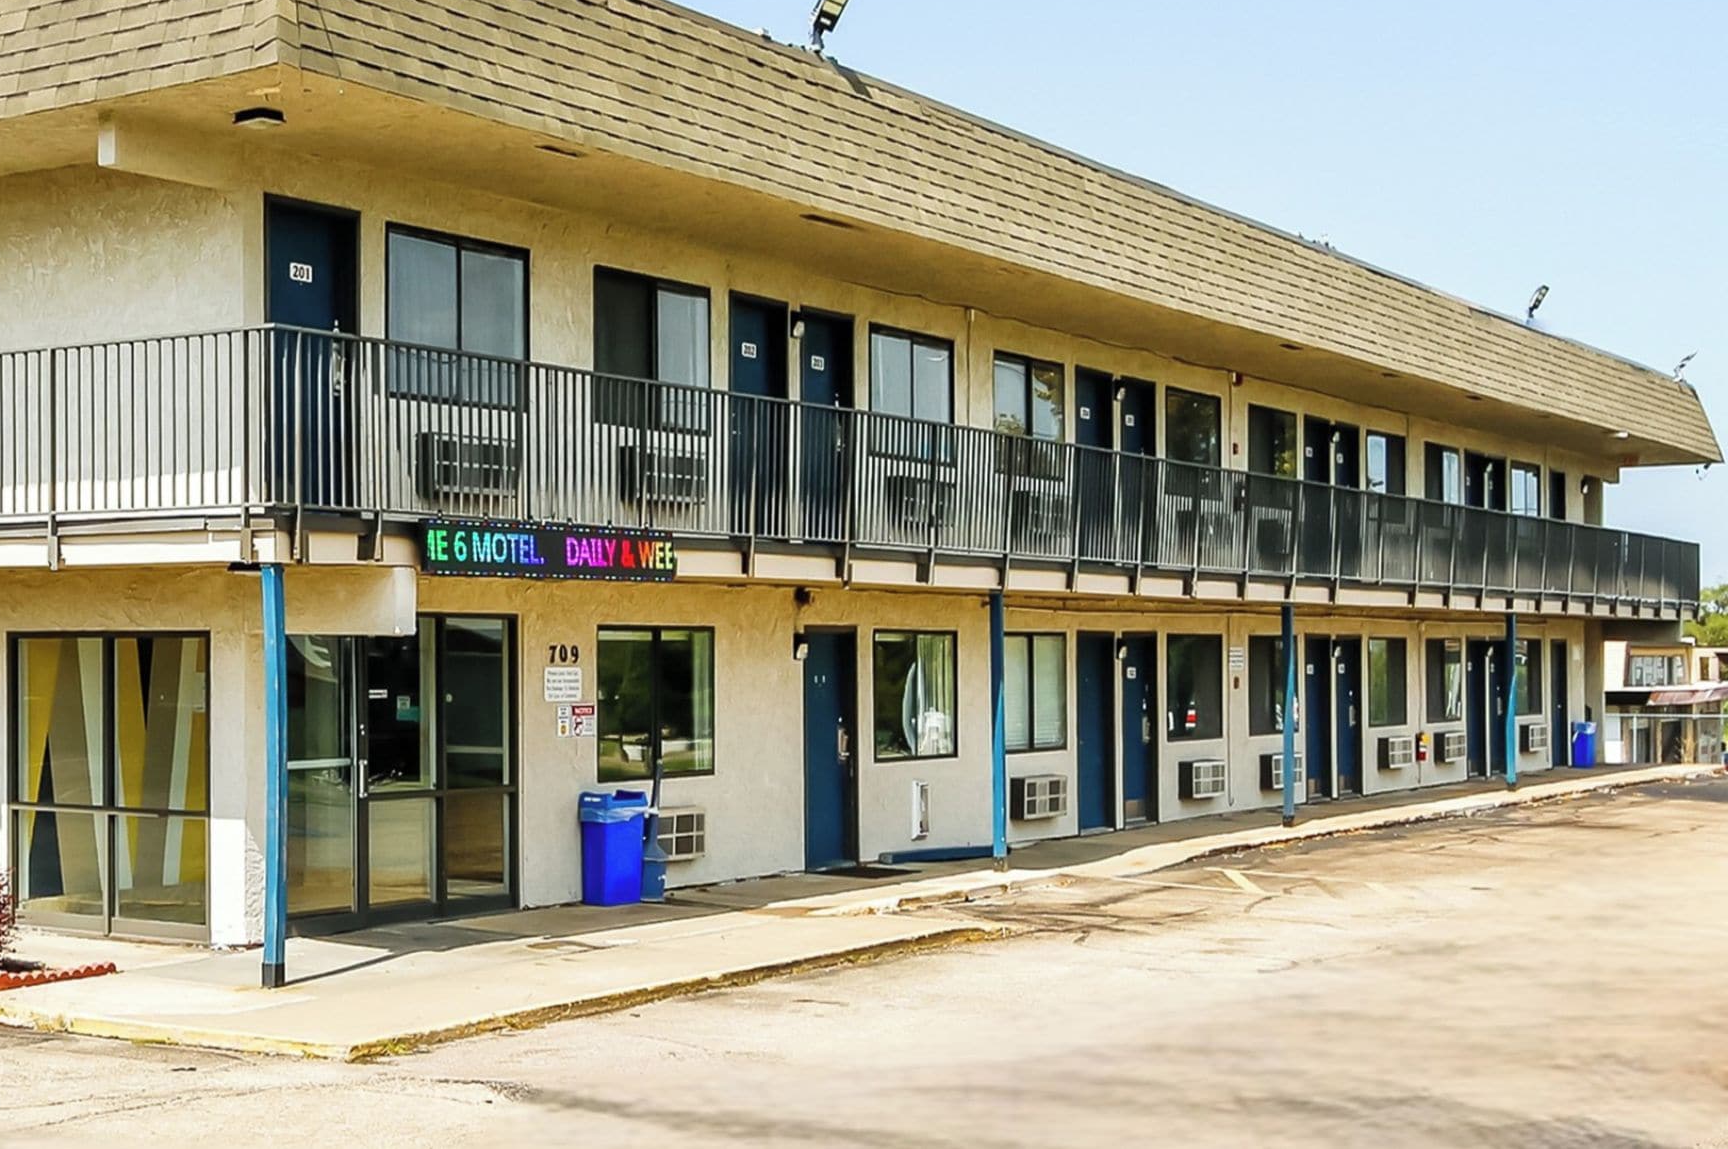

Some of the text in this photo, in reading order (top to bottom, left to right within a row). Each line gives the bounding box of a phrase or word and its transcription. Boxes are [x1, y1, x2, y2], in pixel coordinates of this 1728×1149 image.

[293, 265, 309, 280] 201
[454, 530, 467, 562] 6
[565, 536, 617, 567] DAILY
[620, 538, 636, 569] &
[549, 644, 579, 663] 709
